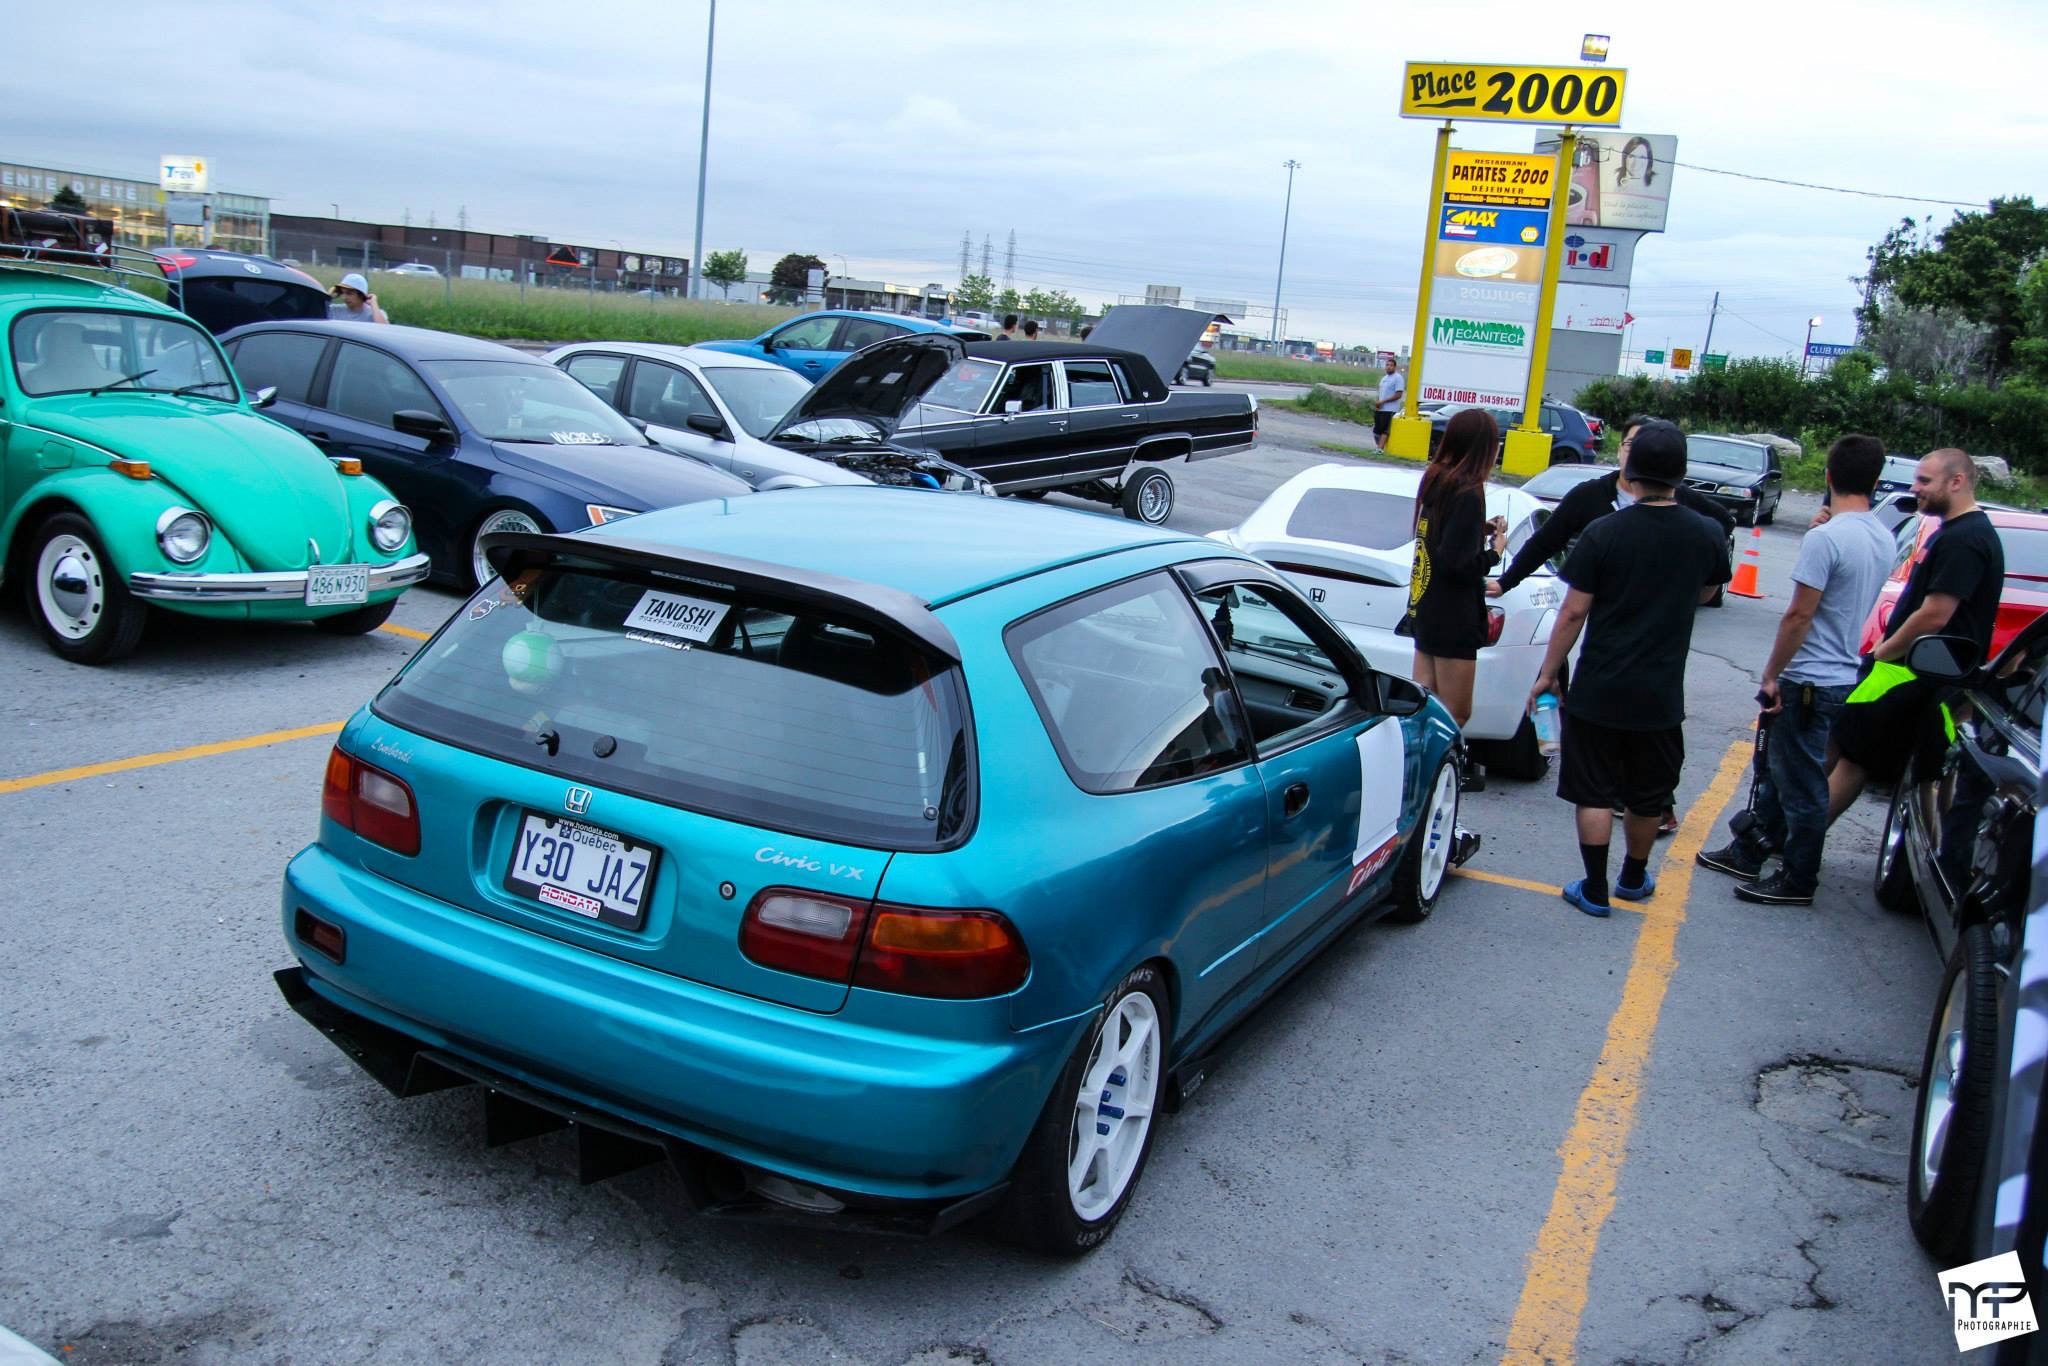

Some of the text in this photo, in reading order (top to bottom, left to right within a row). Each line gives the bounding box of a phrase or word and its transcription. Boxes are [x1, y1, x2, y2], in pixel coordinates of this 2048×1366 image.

[1411, 70, 1617, 117] Place 2000
[1452, 165, 1549, 185] PATATES 2000
[1474, 159, 1528, 167] RESTAURANT
[1434, 321, 1525, 347] MECANITECH
[1810, 345, 1831, 355] CLUB
[1423, 387, 1446, 401] LOCAL
[1453, 390, 1477, 404] LOUER
[644, 598, 716, 627] TANOSHI
[672, 621, 704, 633] LIFESTYLE
[1758, 728, 1766, 752] Canon
[558, 817, 619, 841] www.hondata.com
[572, 830, 617, 854] Québec
[522, 829, 647, 906] Y30 JAZ
[754, 847, 864, 881] Civic VX
[1346, 848, 1392, 897] Civic
[540, 885, 600, 914] HONDATA
